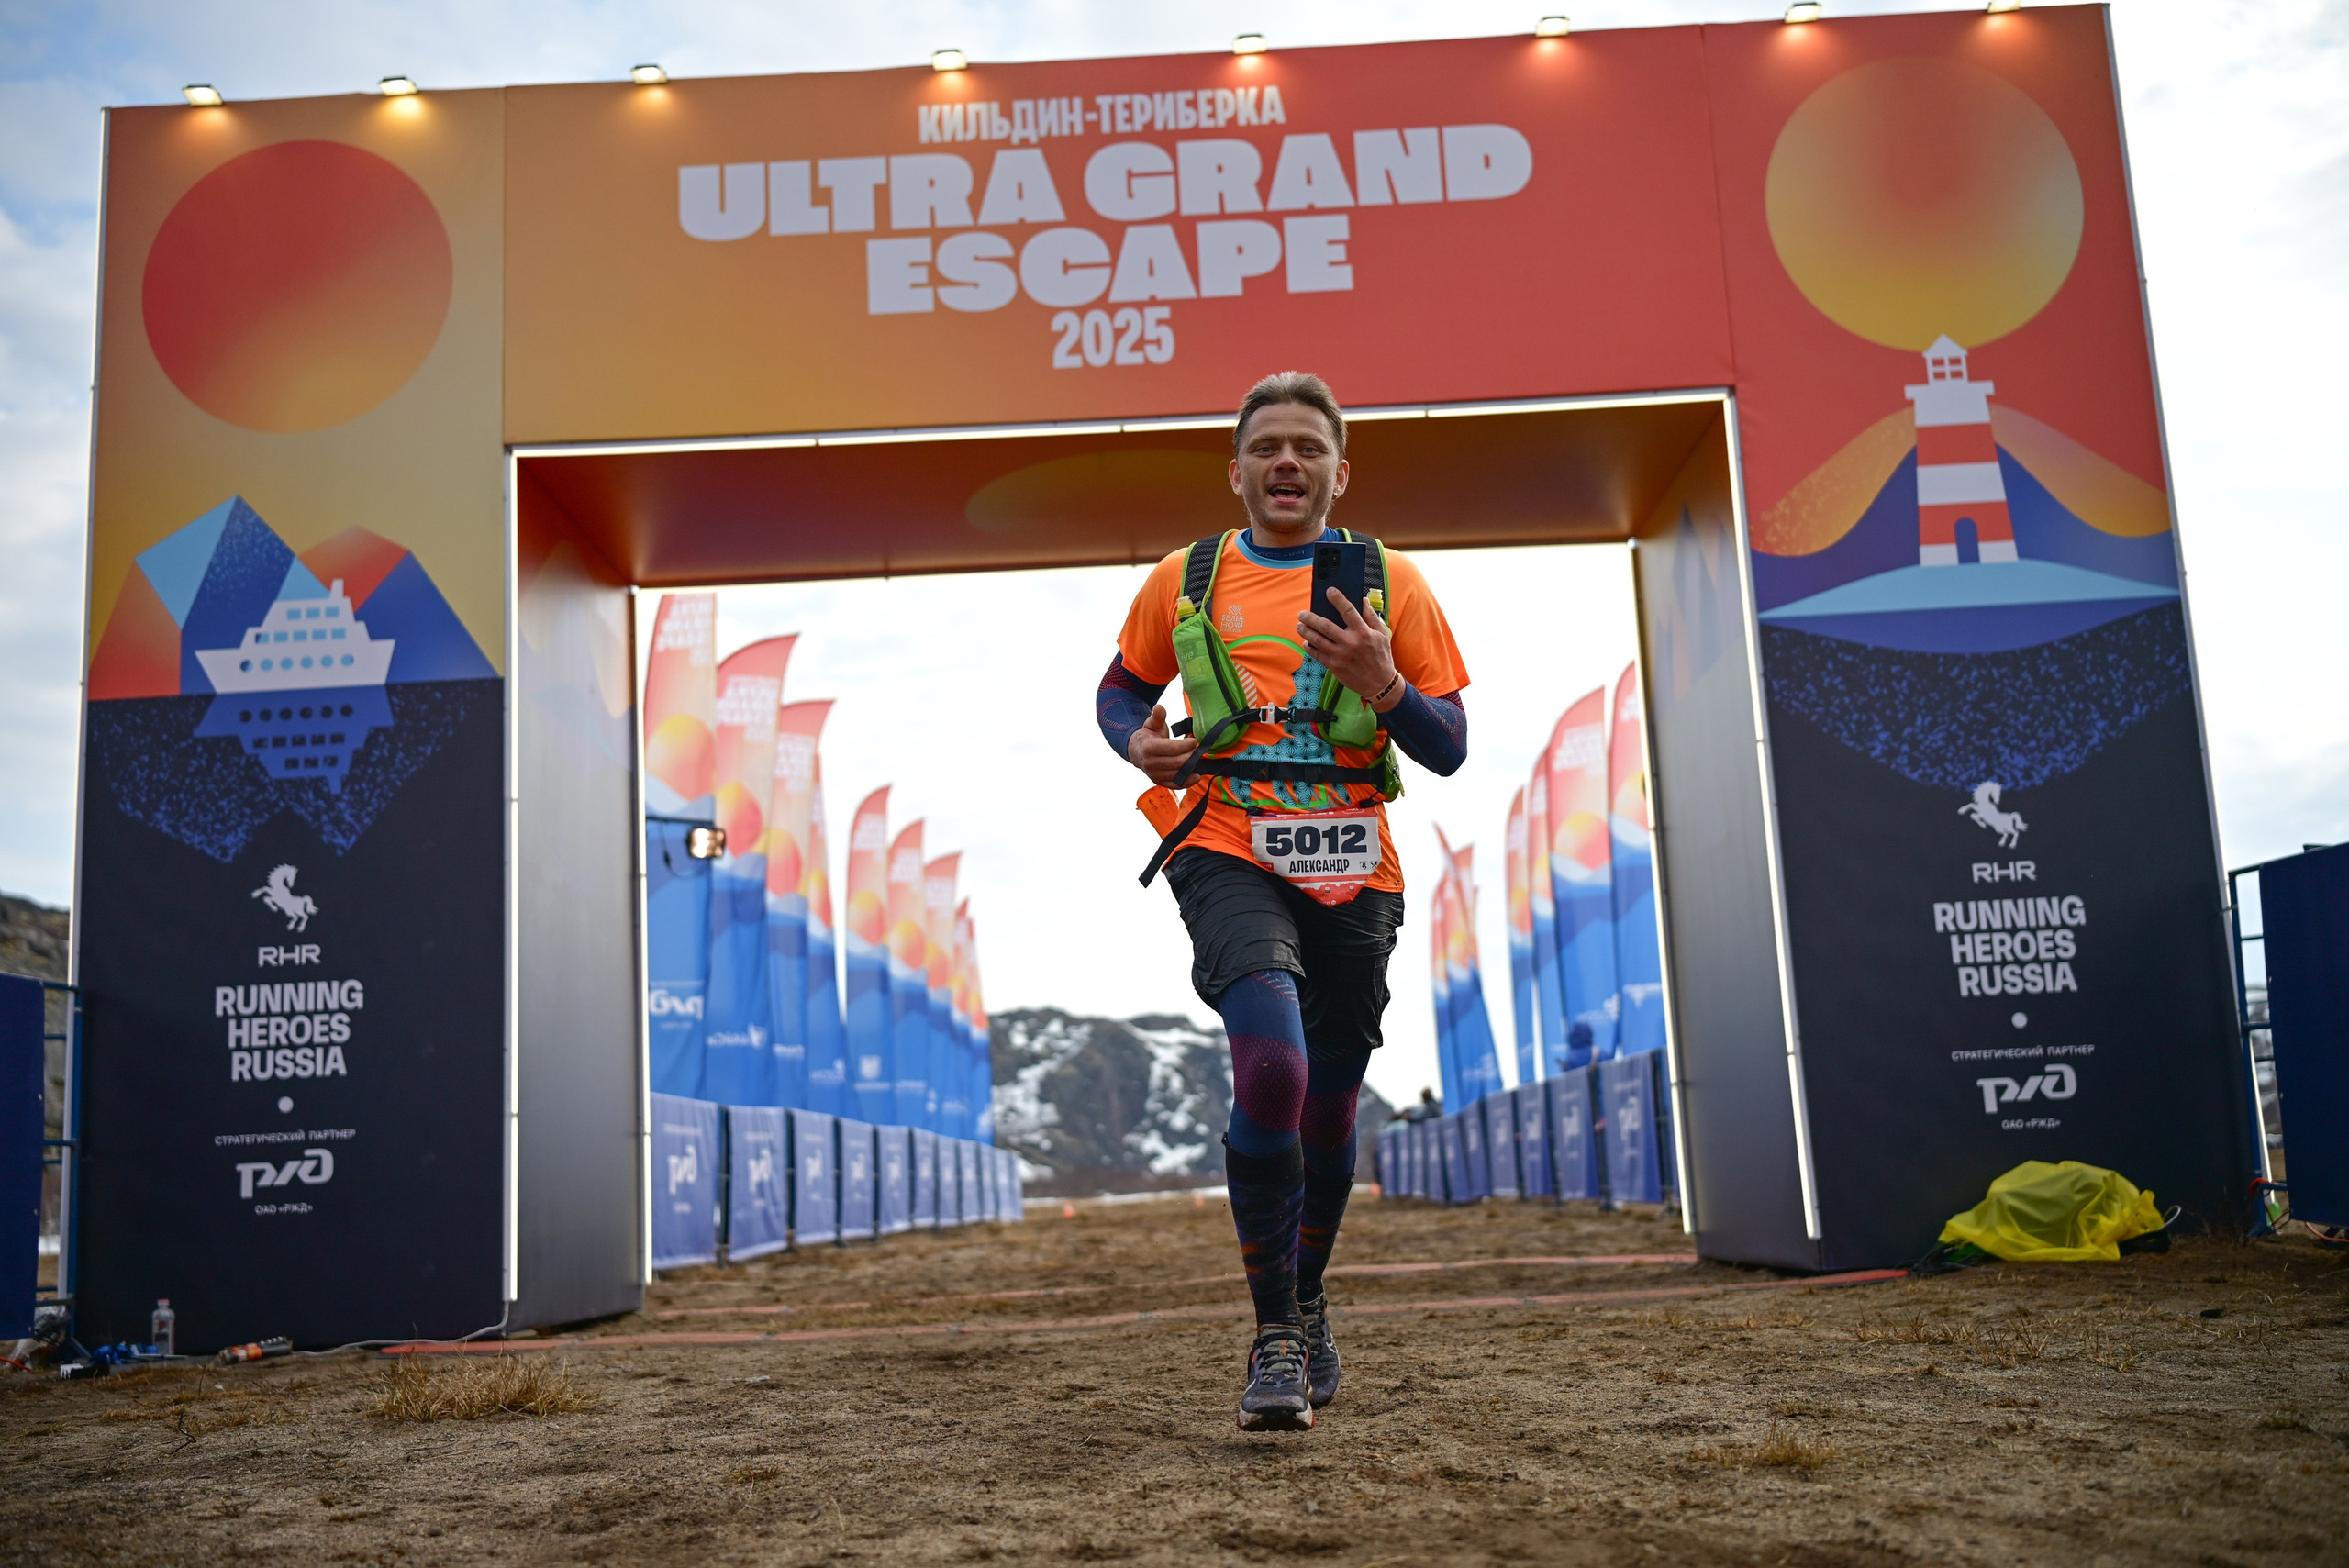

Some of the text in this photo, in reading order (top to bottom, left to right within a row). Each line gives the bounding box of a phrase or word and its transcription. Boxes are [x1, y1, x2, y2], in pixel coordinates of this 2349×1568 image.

[918, 85, 1286, 145] КИЛЬДИН-ТЕРИБЕРКА
[678, 123, 1533, 242] ULTRA GRAND
[865, 213, 1354, 316] ESCAPE
[1051, 306, 1175, 370] 2025
[1265, 824, 1367, 856] 5012
[1288, 858, 1350, 874] АЛЕКСАНДР
[1971, 860, 2037, 884] RHR
[1932, 895, 2087, 933] RUNNING
[258, 943, 321, 967] RHR
[1950, 928, 2076, 964] HEROES
[1957, 961, 2078, 997] RUSSIA
[215, 978, 364, 1018] RUNNING
[228, 1012, 351, 1050] HEROES
[230, 1045, 348, 1082] RUSSIA
[1951, 1043, 2095, 1062] СТРАТЕГИЧЕСКИЙ ПАРТНЕР
[214, 1128, 356, 1147] СТРАТЕГИЧЕСКИЙ ПАРТНЕР
[2001, 1118, 2024, 1129] ОАО
[254, 1203, 277, 1216] ОАО
